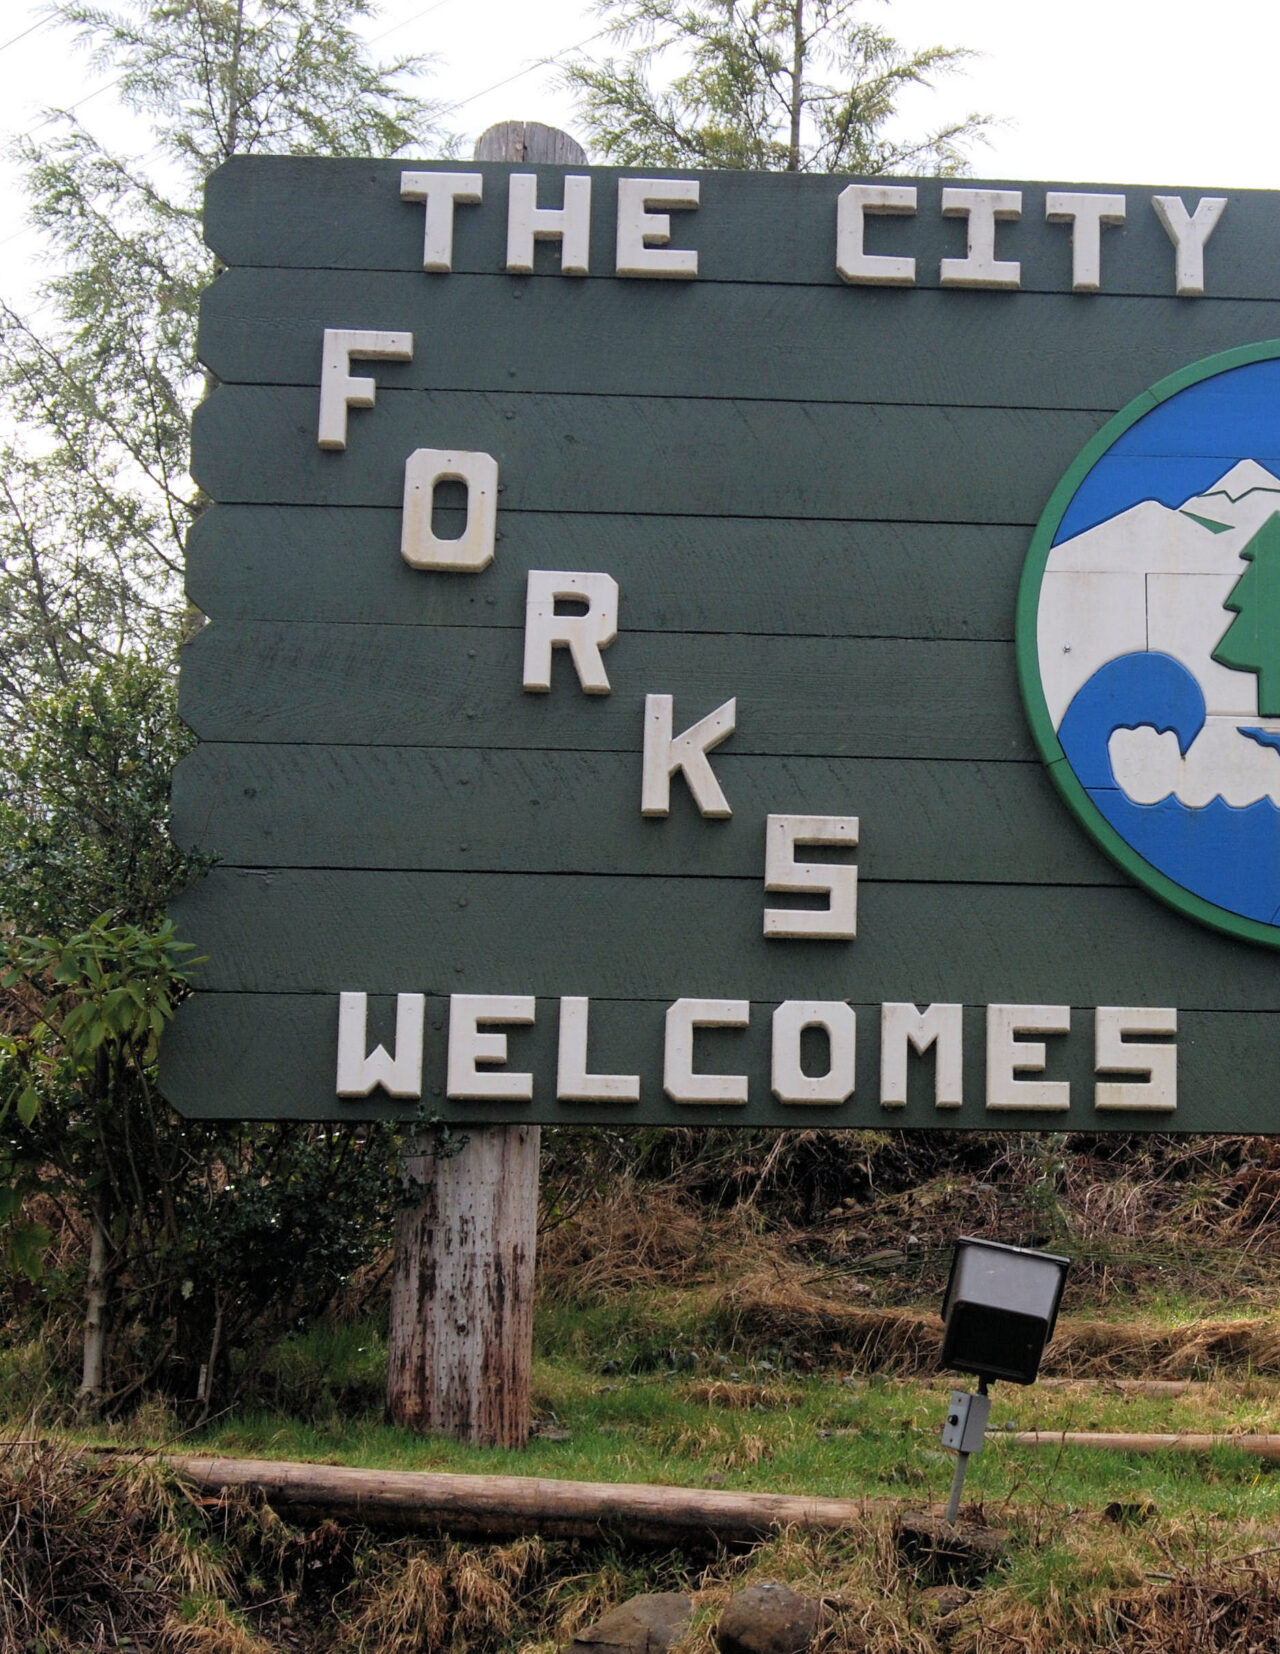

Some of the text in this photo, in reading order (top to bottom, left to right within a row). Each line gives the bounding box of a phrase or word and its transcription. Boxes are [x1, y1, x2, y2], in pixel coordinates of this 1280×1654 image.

[401, 170, 703, 283] THE
[835, 183, 1228, 298] CITY
[317, 327, 861, 941] FORKS
[335, 991, 1179, 1112] WELCOMES
